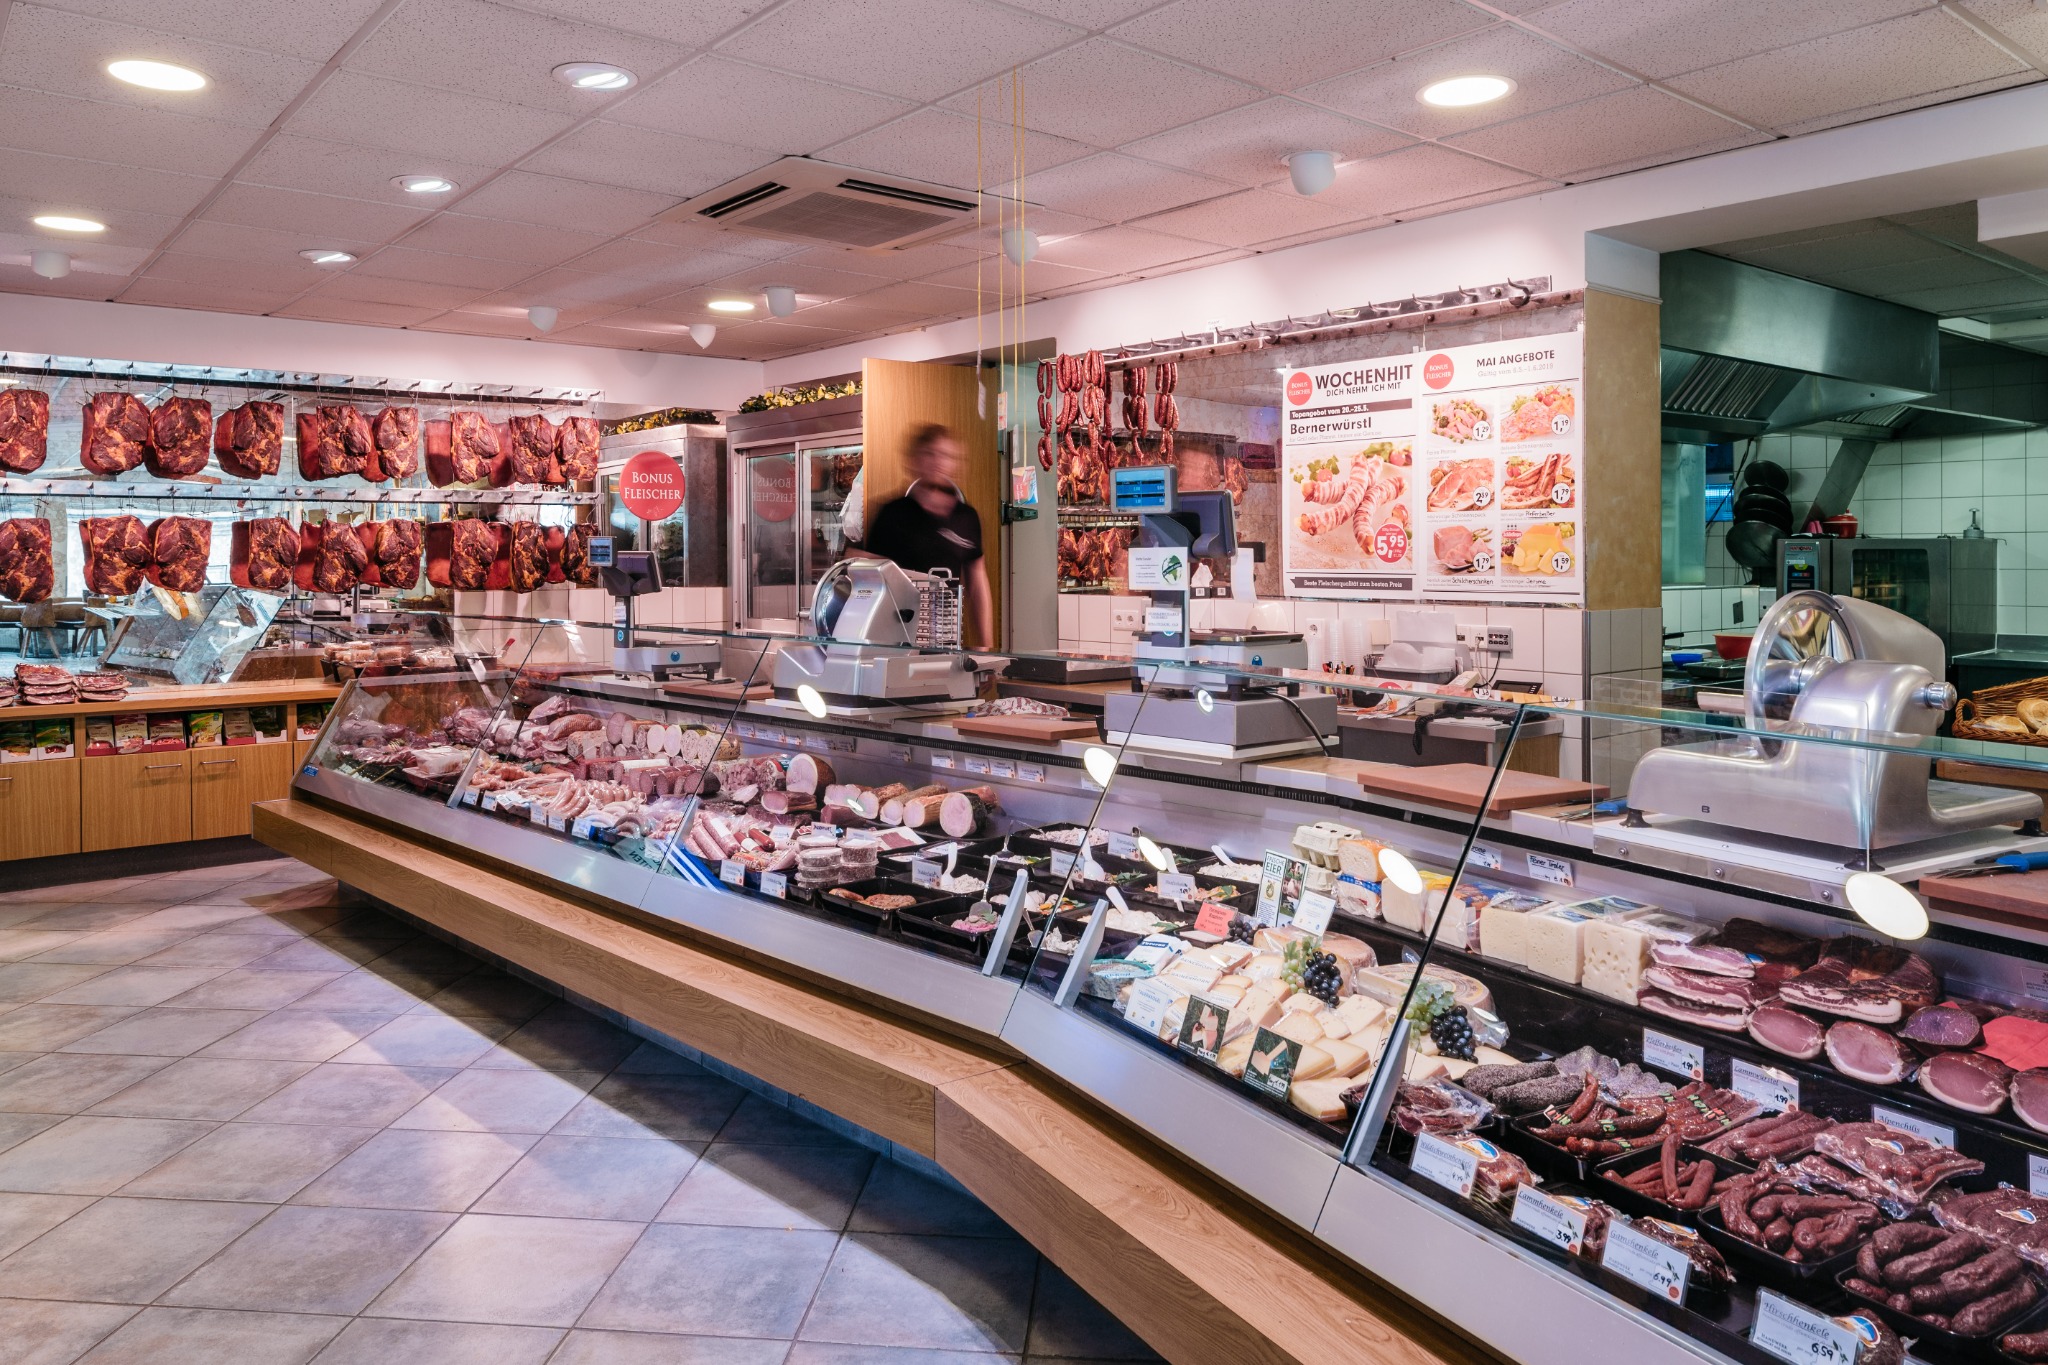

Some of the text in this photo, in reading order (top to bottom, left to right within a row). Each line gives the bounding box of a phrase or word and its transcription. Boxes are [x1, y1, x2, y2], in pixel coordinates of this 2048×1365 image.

[1476, 350, 1555, 368] MAI ANGEBOTE
[1430, 364, 1448, 372] BONUS
[1316, 364, 1413, 389] WOCHENHIT
[1426, 371, 1451, 380] FLEISCHER
[1326, 388, 1344, 396] DICH
[1346, 386, 1368, 394] NEHM
[1372, 384, 1384, 392] ICH
[1292, 409, 1327, 419] Topangebot
[1290, 417, 1372, 435] Bernerwürstl
[1476, 426, 1490, 438] 1,29
[1554, 419, 1569, 432] 1,19
[632, 471, 673, 485] BONUS
[624, 487, 682, 500] FLEISCHER
[1554, 488, 1569, 501] 1,79
[1376, 535, 1404, 559] 5,95
[1476, 558, 1490, 569] 1,79
[1554, 557, 1569, 569] 1,59
[1266, 855, 1285, 866] FRISCHE
[1266, 862, 1282, 875] EIER
[1682, 1061, 1693, 1071] 1.99
[1775, 1094, 1788, 1104] 1.99
[1878, 1115, 1920, 1134] Alpenchilis
[1518, 1190, 1564, 1219] Lammhenkele
[1556, 1229, 1572, 1244] 3.99
[1610, 1230, 1659, 1258] Gamshenkele
[1653, 1272, 1672, 1287] 6.99
[1763, 1302, 1830, 1339] Hirschhenkele
[1812, 1342, 1834, 1361] 6.59
